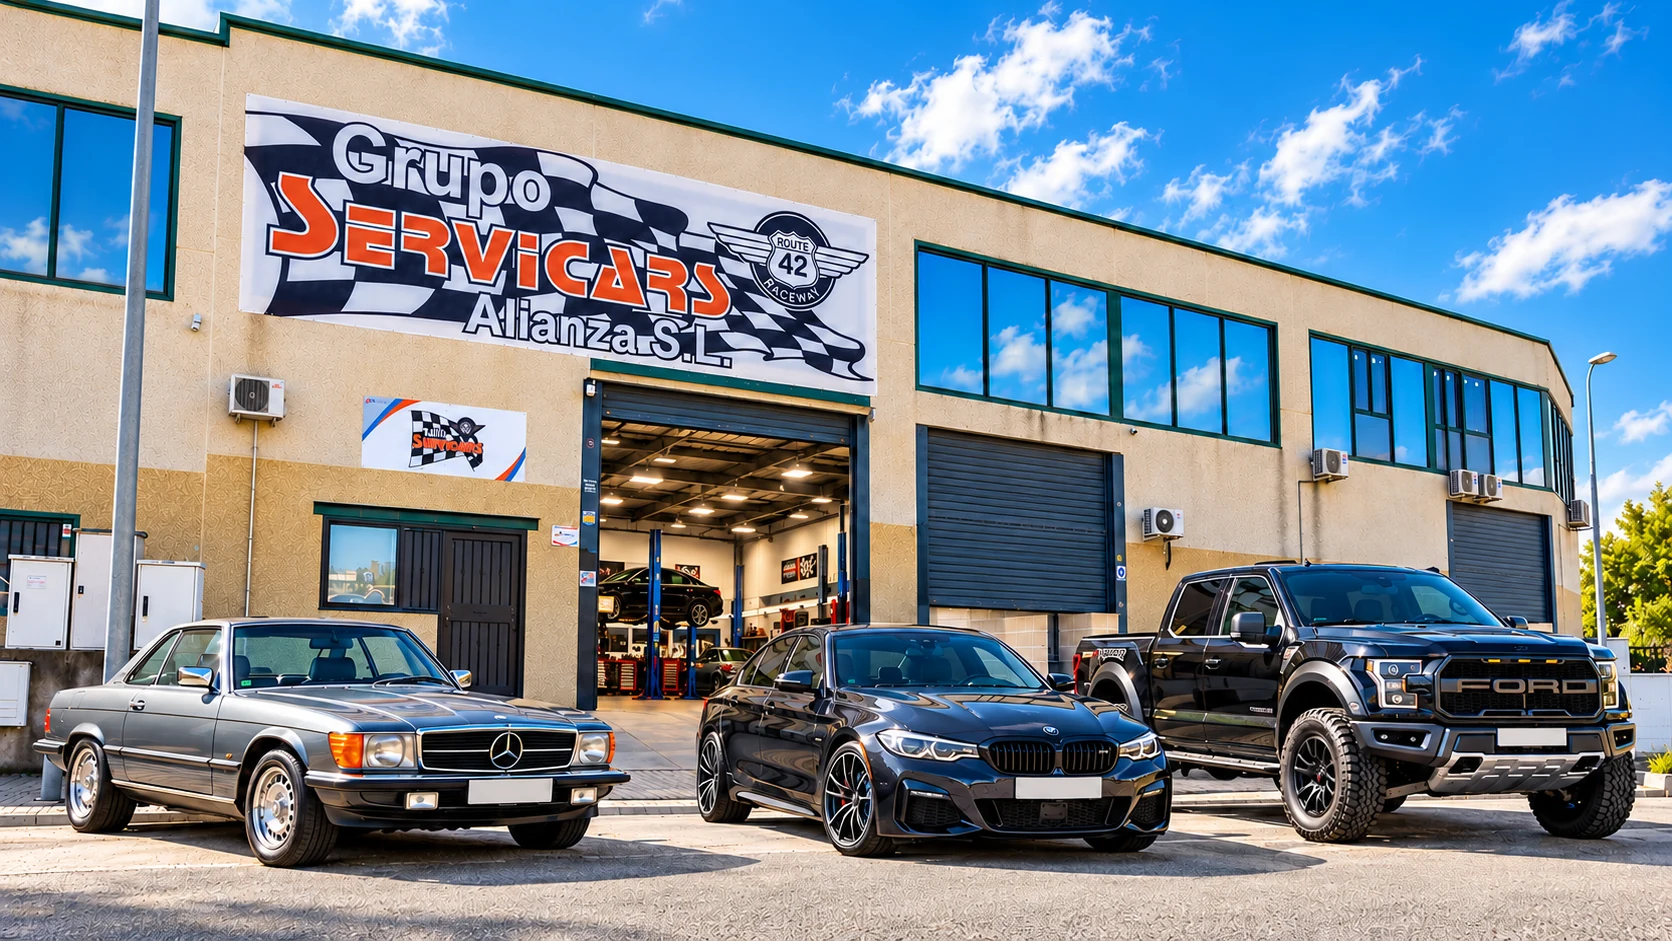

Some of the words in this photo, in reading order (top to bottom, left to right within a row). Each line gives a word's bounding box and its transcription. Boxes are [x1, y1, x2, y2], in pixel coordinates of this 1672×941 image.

[332, 121, 552, 219] Grupo
[776, 236, 809, 252] ROUTE
[778, 252, 808, 279] 42
[763, 278, 820, 303] RACEWAY
[462, 292, 639, 355] Alianza
[650, 316, 733, 369] S.L.
[1455, 678, 1597, 694] FORD
